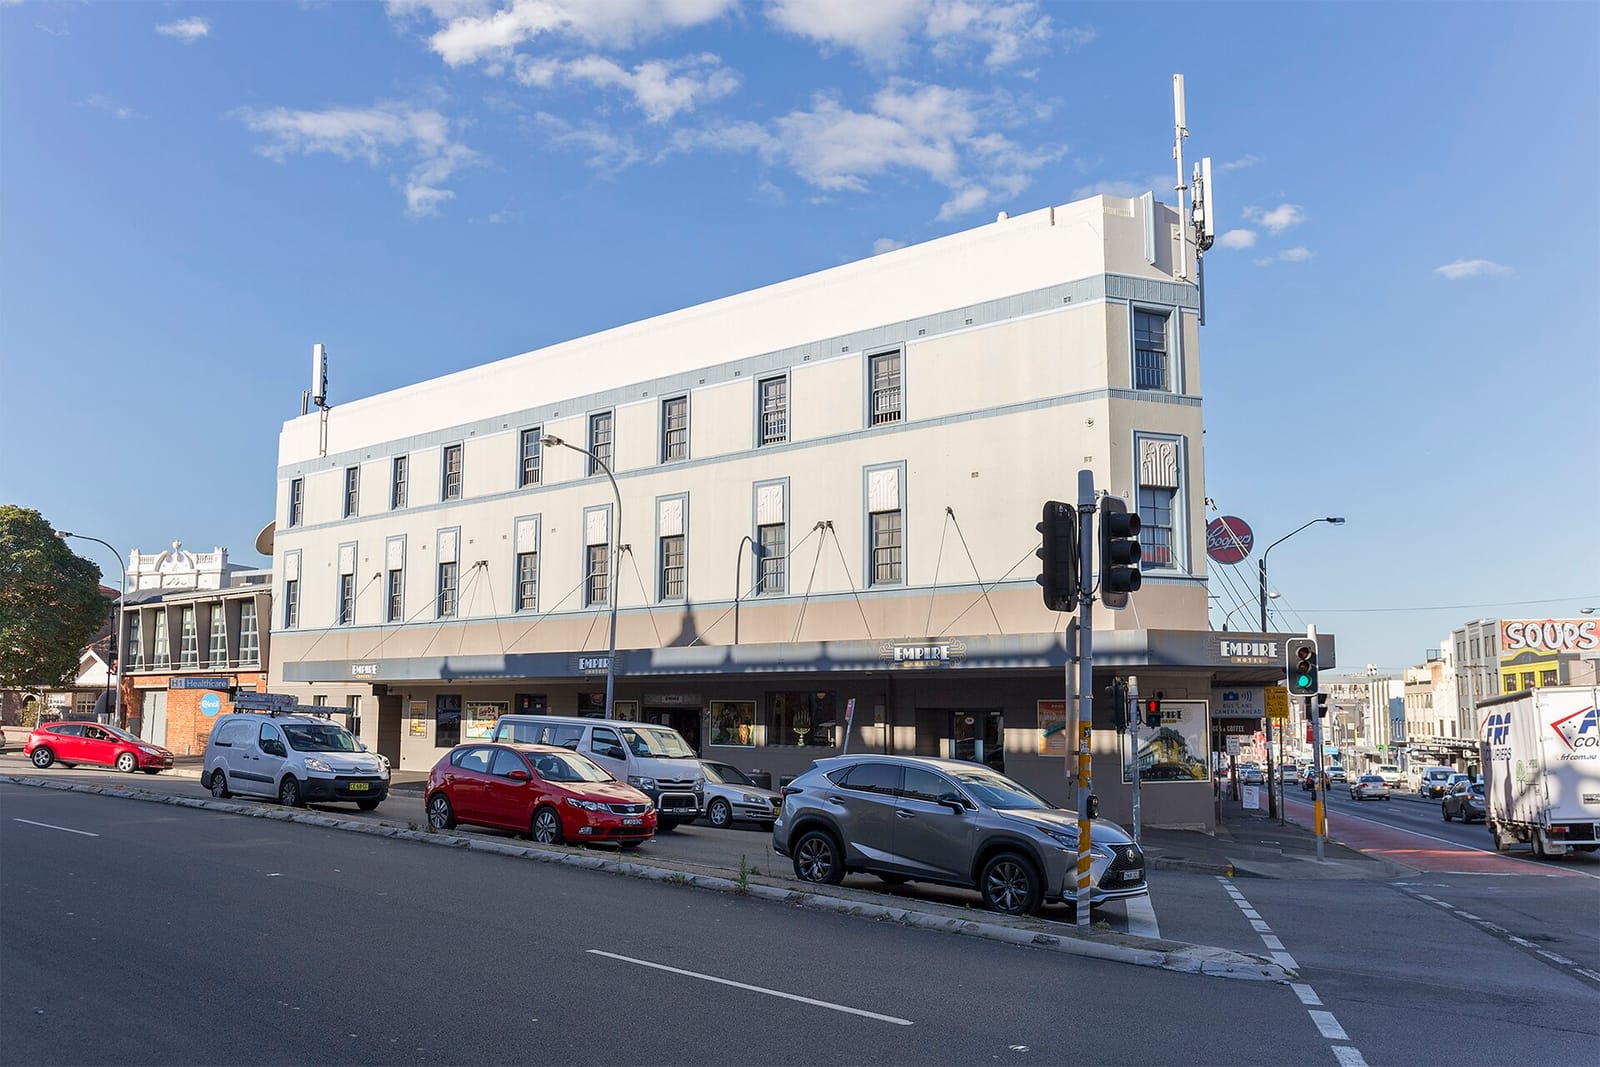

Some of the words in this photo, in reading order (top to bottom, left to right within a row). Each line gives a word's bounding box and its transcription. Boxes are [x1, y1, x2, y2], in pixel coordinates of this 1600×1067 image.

[894, 645, 950, 661] EMPIRE
[1220, 641, 1278, 658] EMPIRE
[578, 658, 612, 669] EMPIR
[186, 679, 227, 687] Healthcare
[1160, 711, 1182, 719] PIRE
[1487, 712, 1511, 745] FRF
